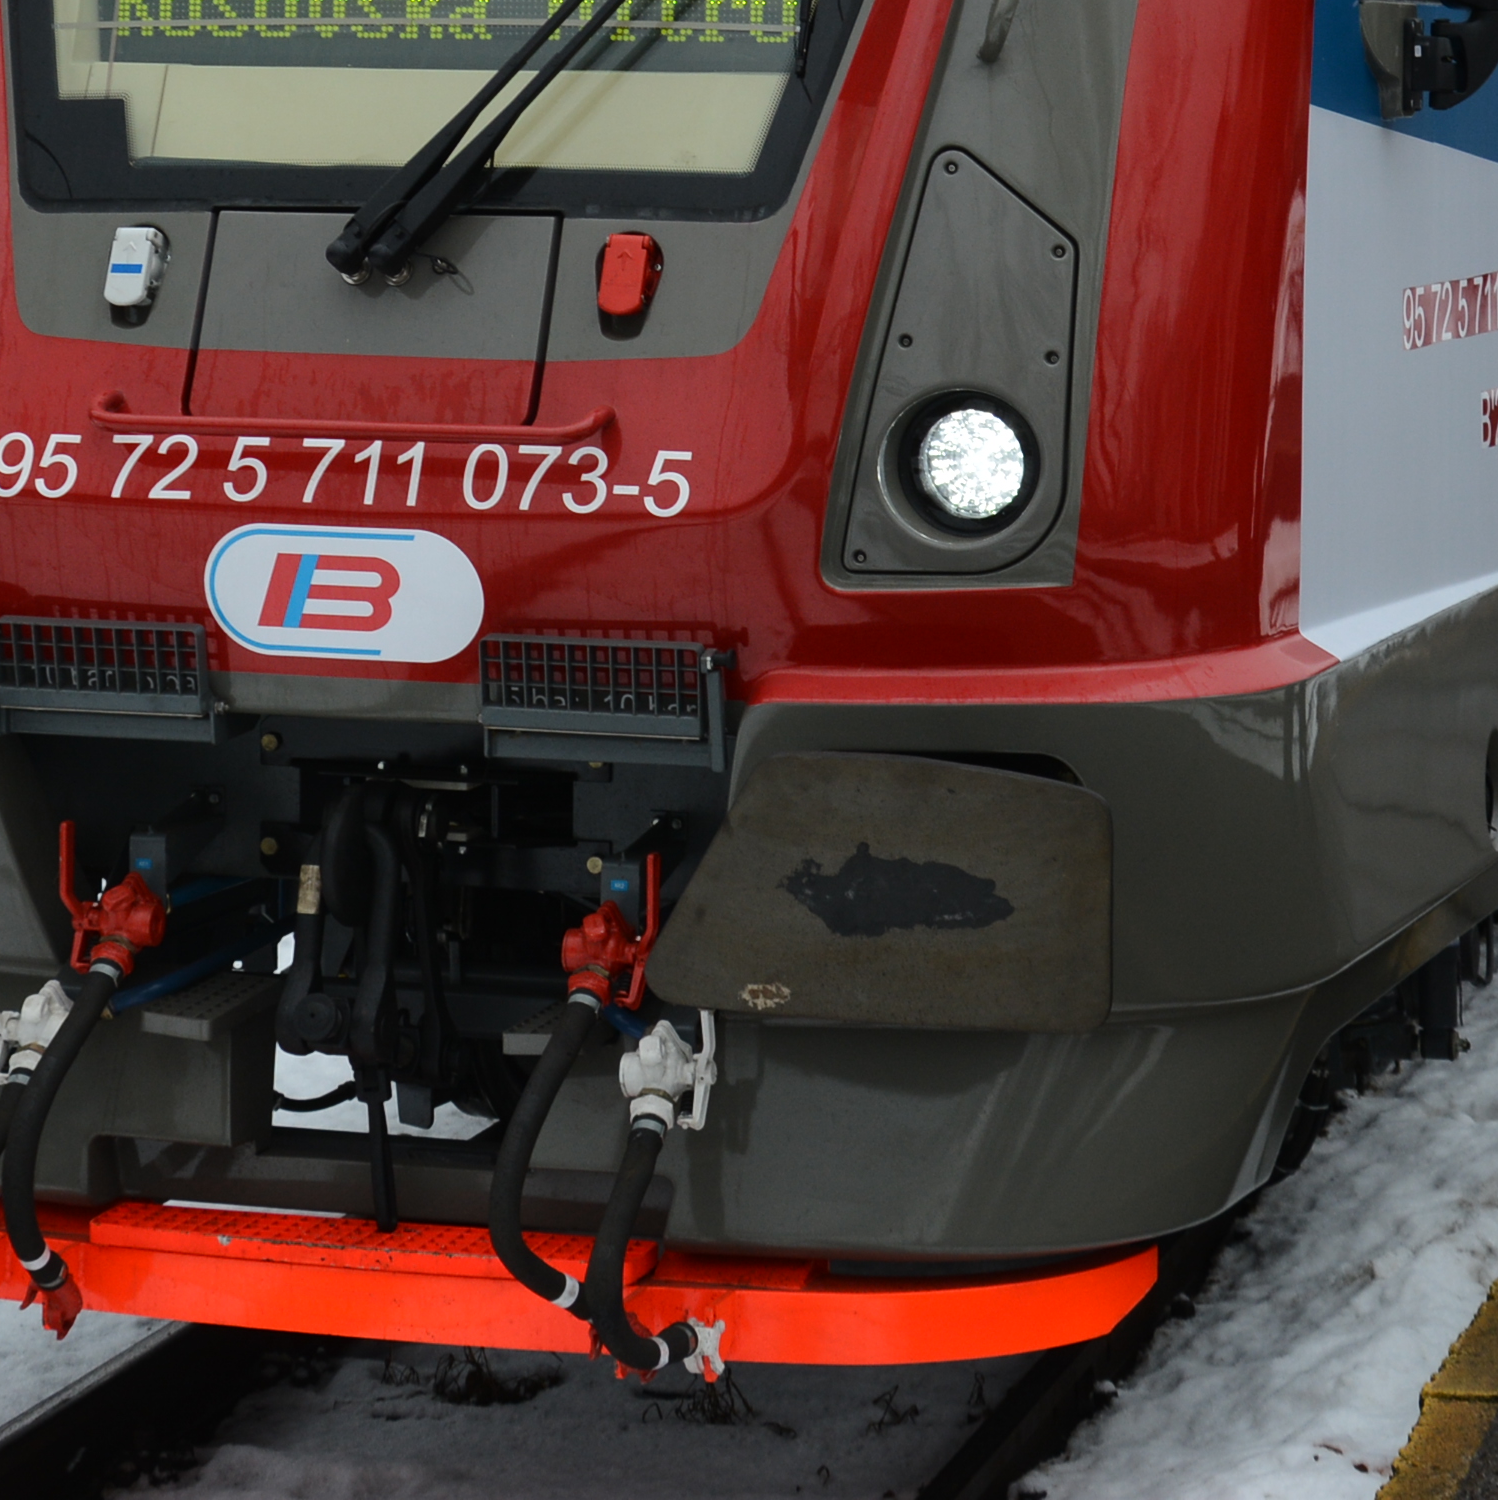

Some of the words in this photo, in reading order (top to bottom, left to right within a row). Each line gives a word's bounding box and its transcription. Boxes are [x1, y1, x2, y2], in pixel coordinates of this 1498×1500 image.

[1403, 288, 1426, 350] 95
[1431, 281, 1453, 343] 72
[1458, 279, 1469, 338] 5
[109, 433, 200, 500] 72
[222, 436, 271, 503] 5
[301, 438, 427, 507] 711
[462, 442, 693, 518] 073-5
